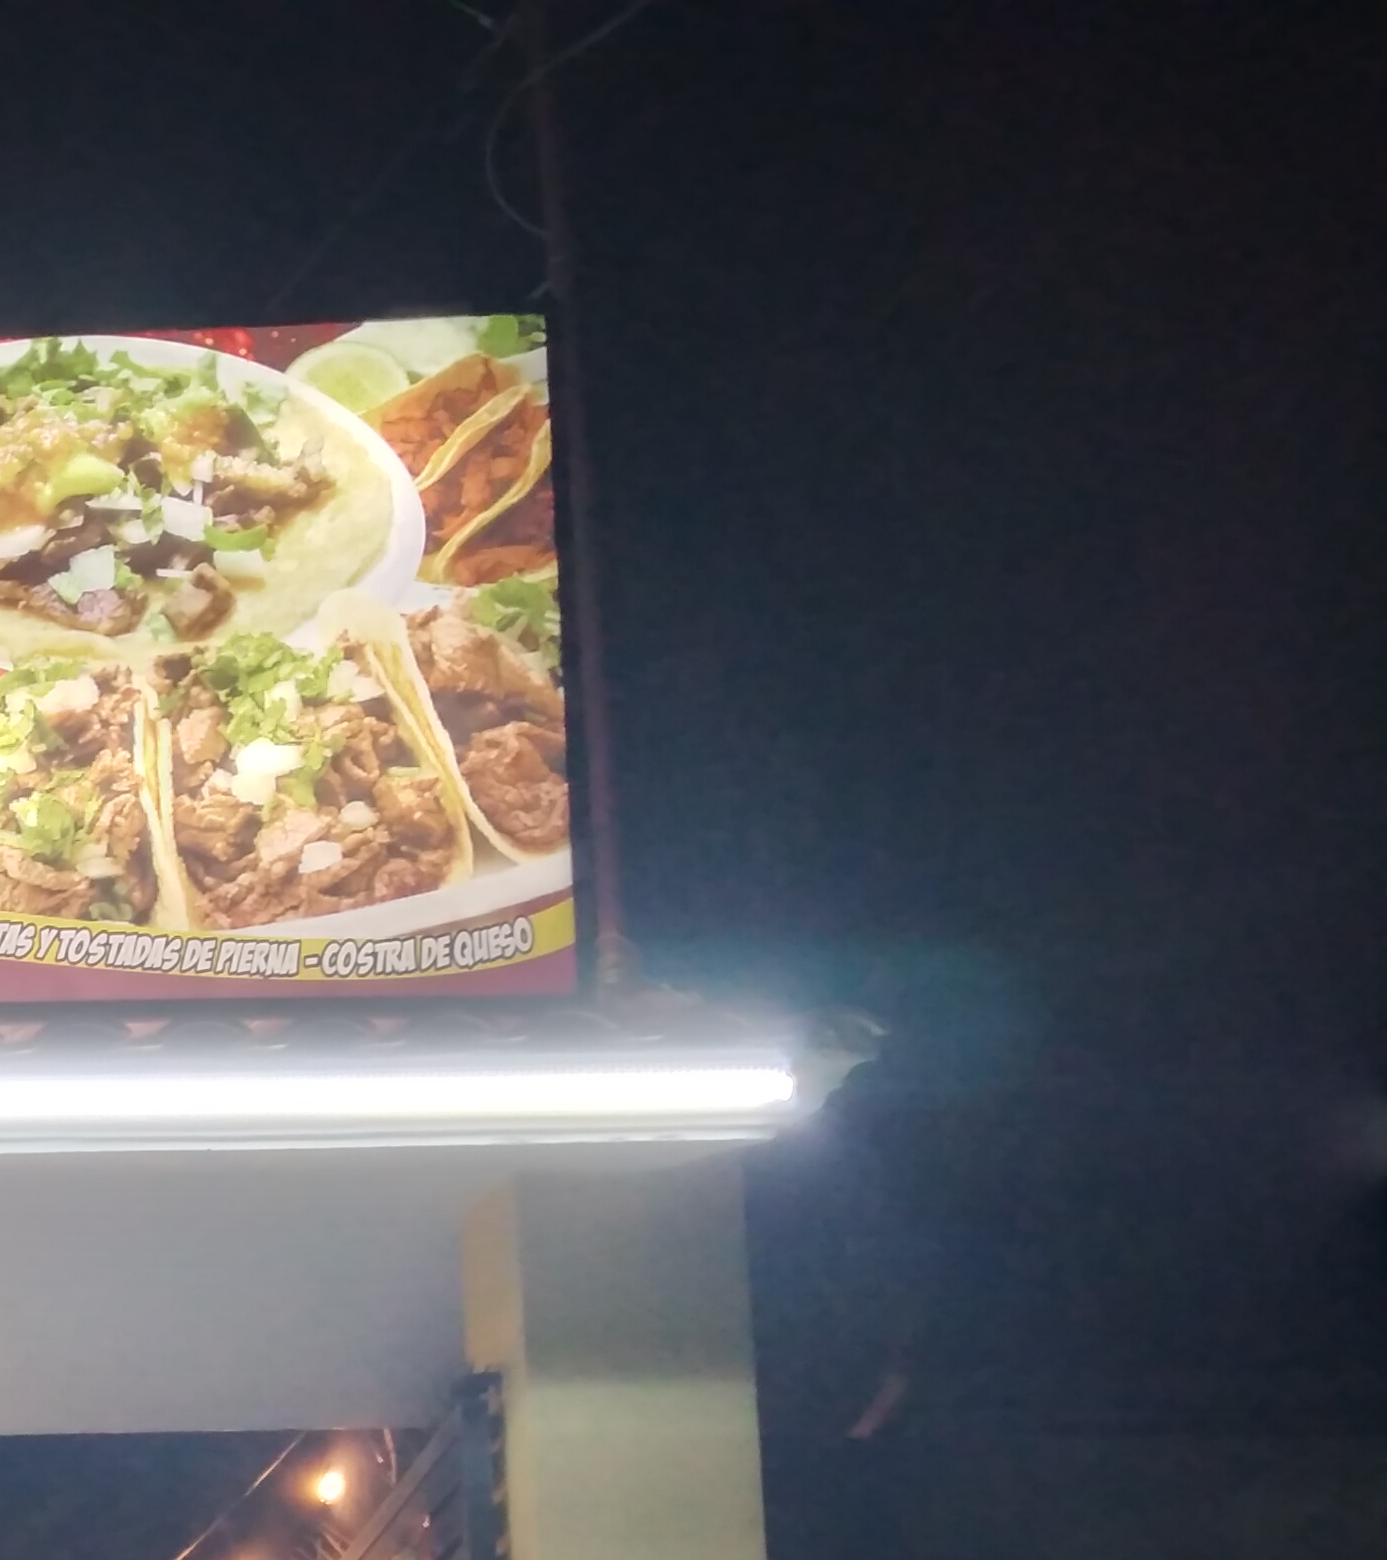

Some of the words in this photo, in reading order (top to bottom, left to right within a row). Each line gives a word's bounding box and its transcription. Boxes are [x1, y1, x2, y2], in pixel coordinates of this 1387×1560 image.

[28, 927, 60, 962] Y
[54, 928, 183, 973] TOSTADAS
[177, 936, 217, 975] DE
[215, 938, 302, 979] PIERNA
[322, 935, 417, 979] COSTRA
[420, 933, 454, 971] DE
[453, 914, 534, 968] QUESO
